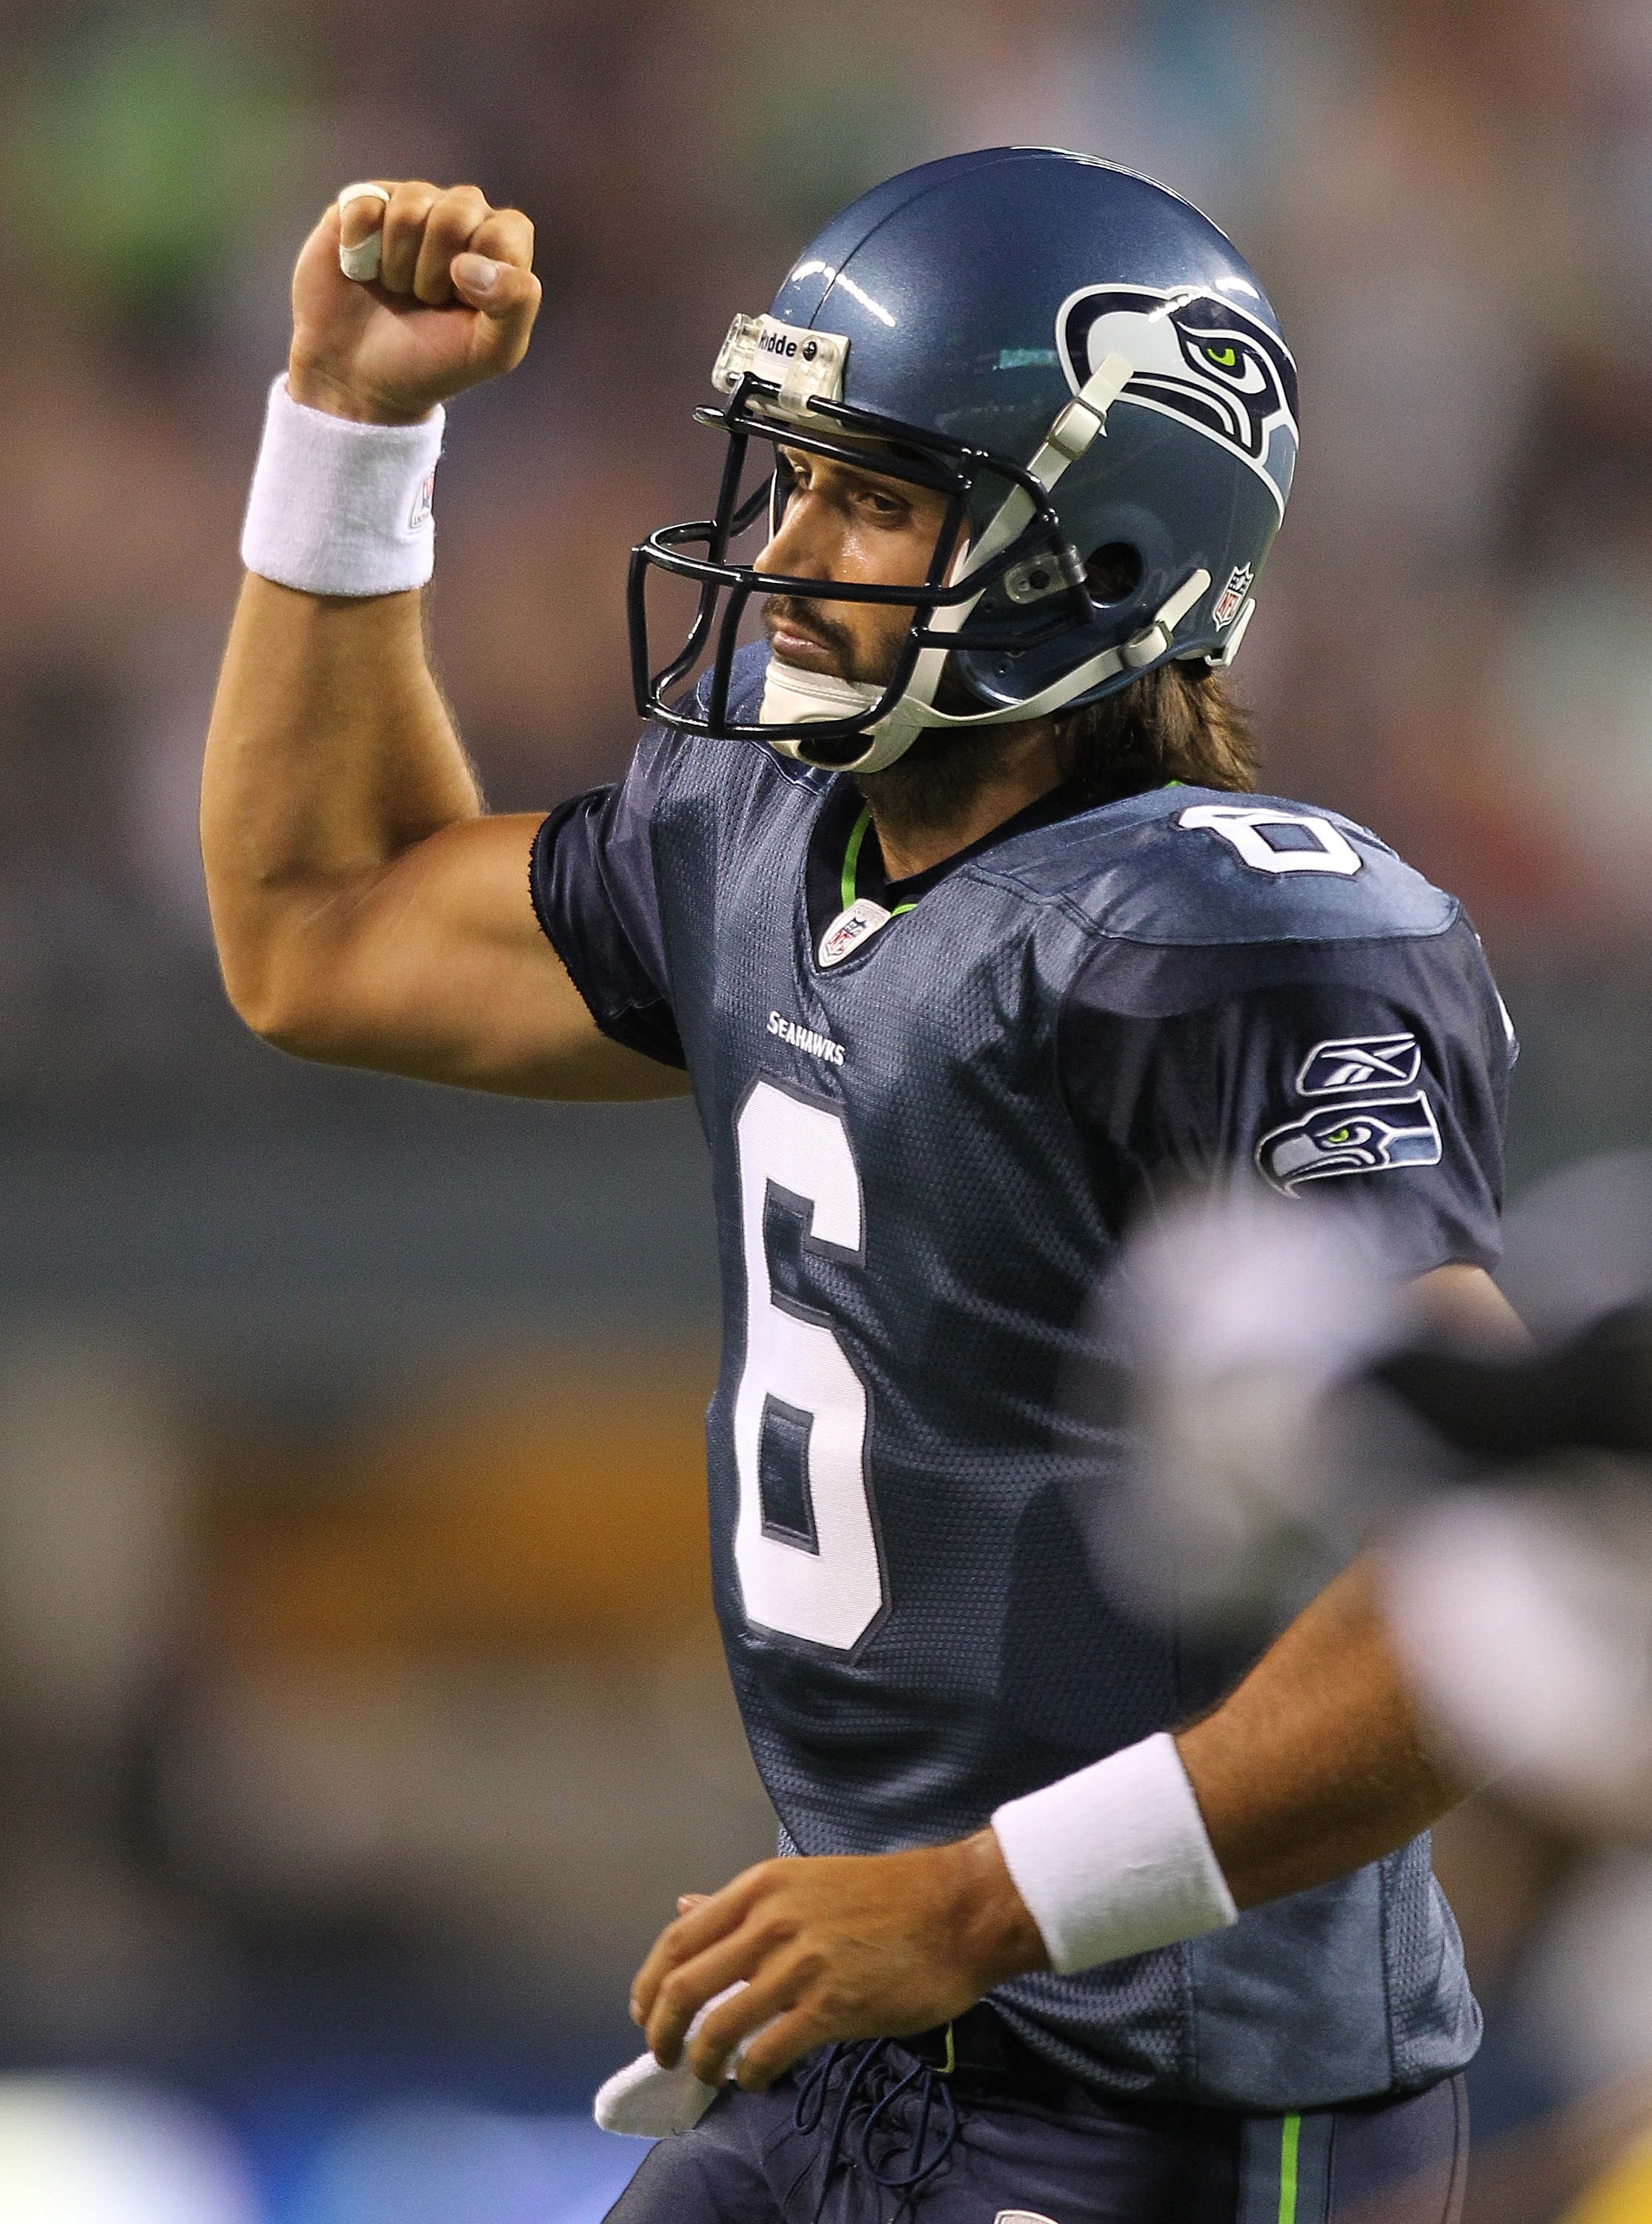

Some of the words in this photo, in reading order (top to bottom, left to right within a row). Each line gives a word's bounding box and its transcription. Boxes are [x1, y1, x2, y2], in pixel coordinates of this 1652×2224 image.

[758, 329, 798, 357] Ridde
[766, 1010, 846, 1066] SEAHAWKS
[734, 1080, 884, 1651] 6
